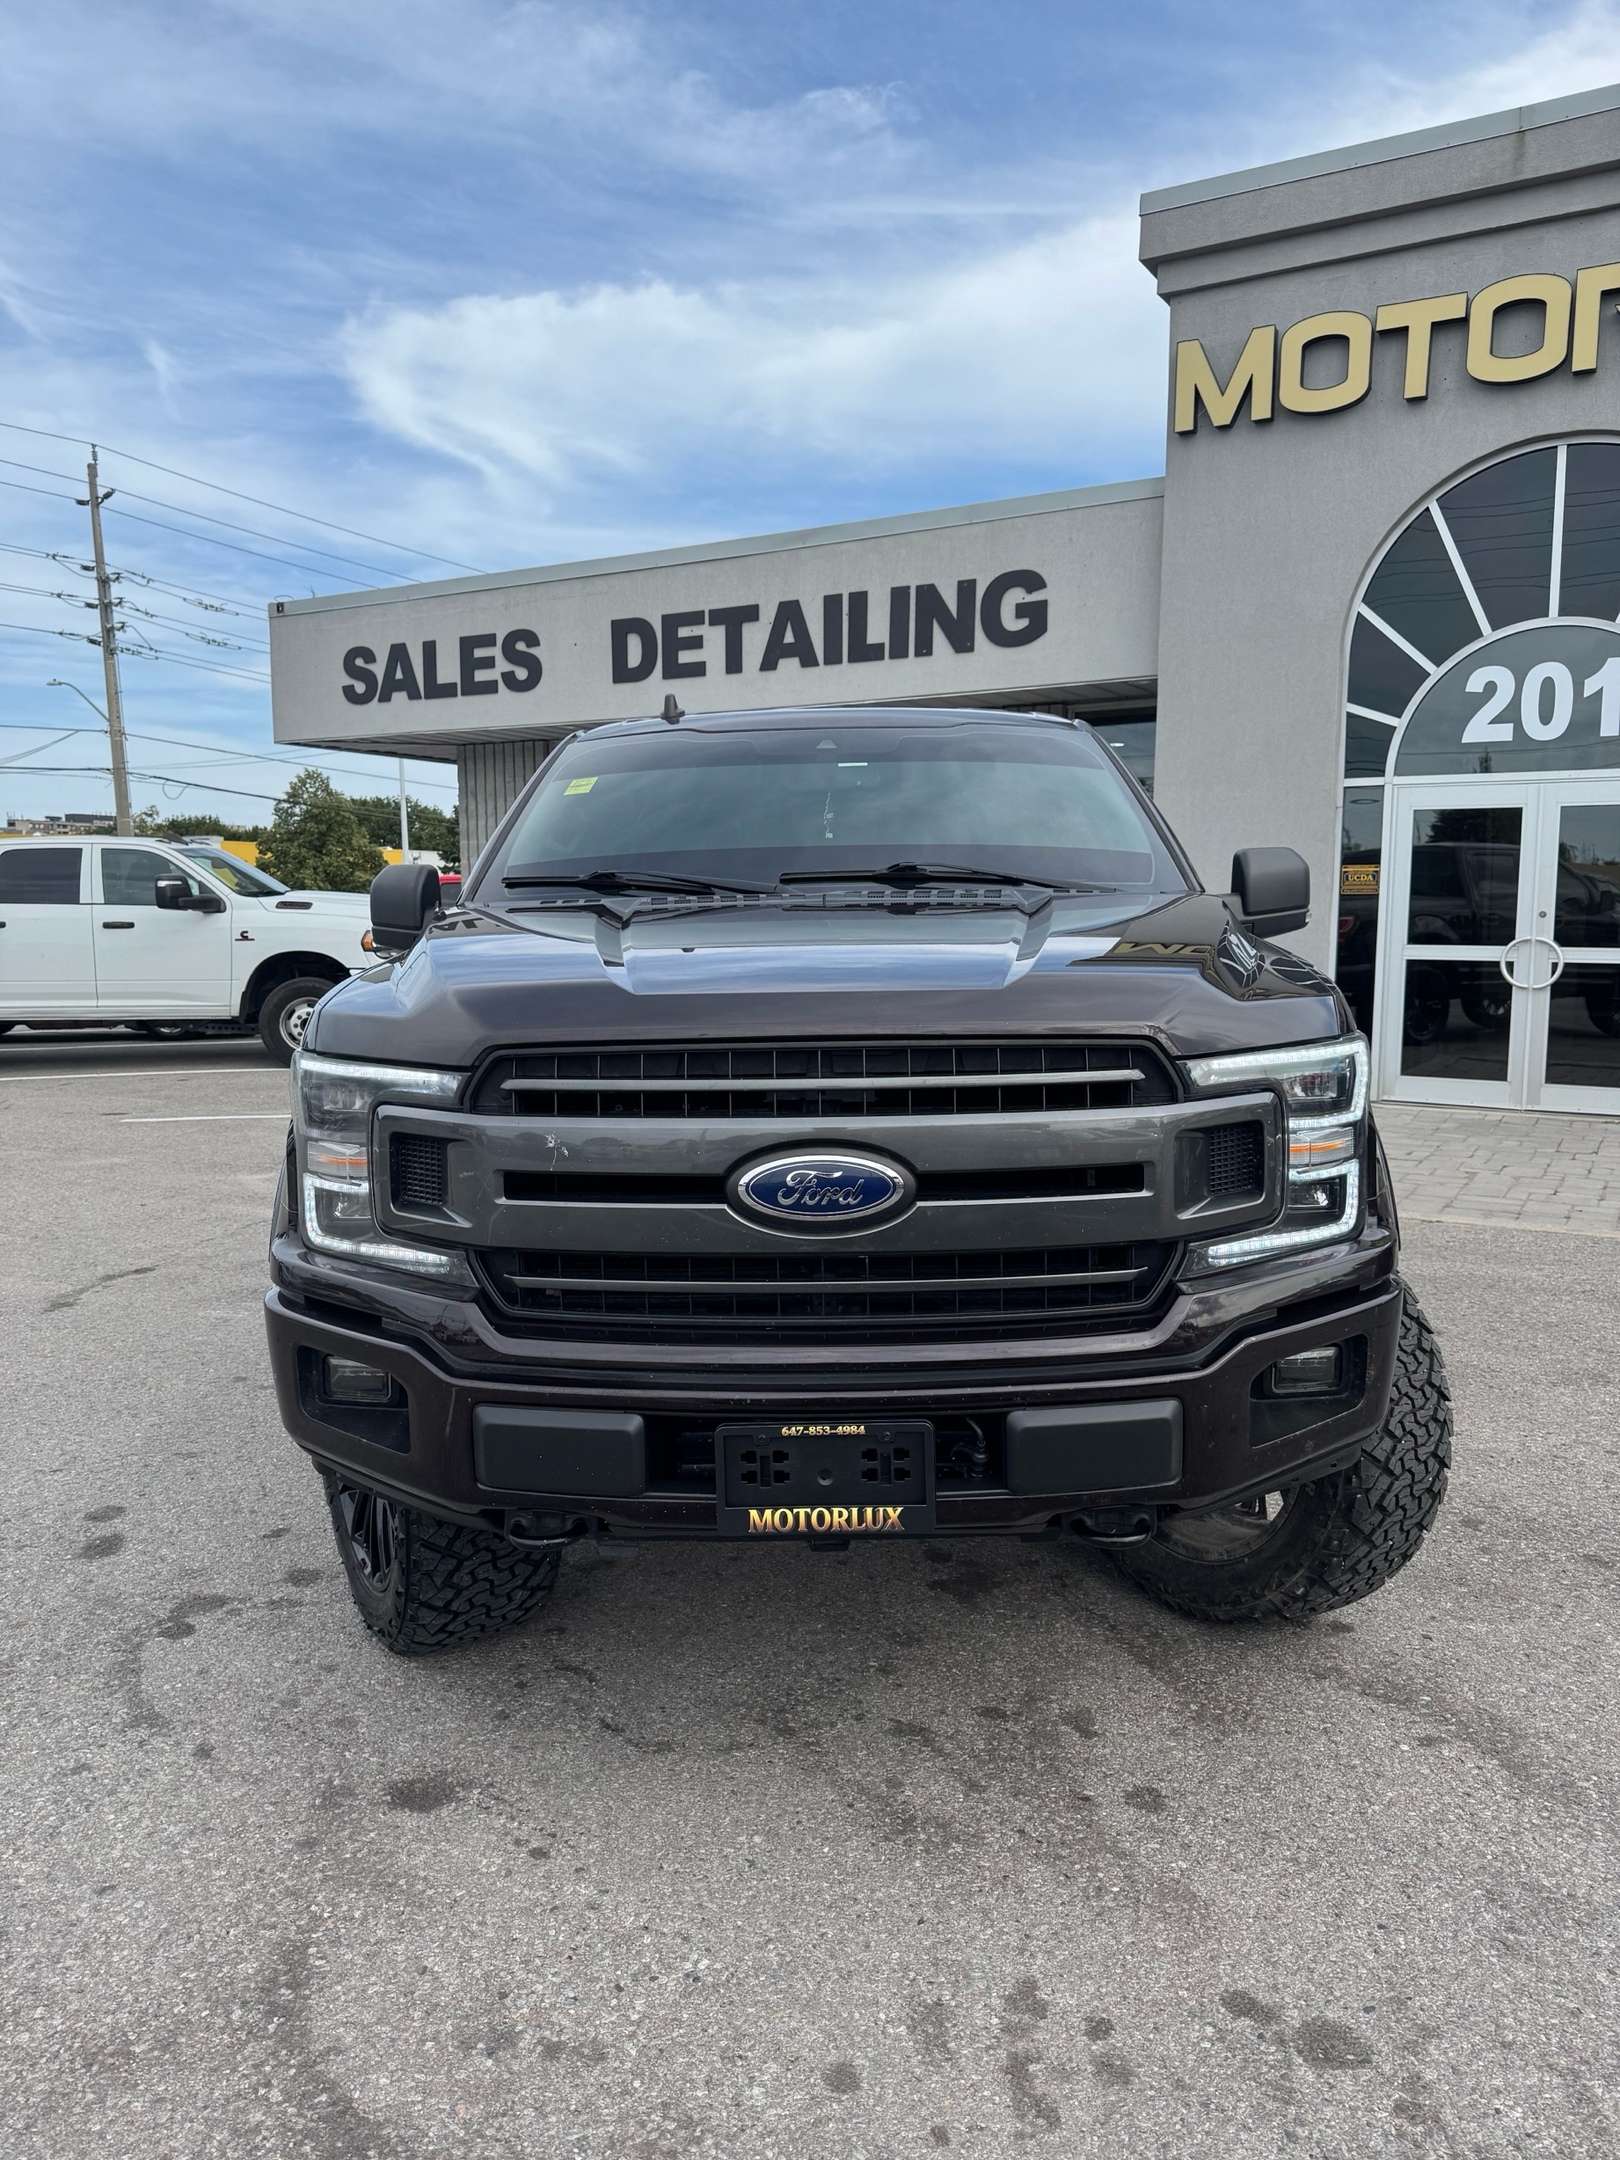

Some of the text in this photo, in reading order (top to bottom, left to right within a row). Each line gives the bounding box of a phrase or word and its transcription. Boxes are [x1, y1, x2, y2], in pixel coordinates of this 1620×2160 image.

[341, 569, 1048, 706] SALES DETAILING
[1461, 656, 1620, 743] 201
[777, 1170, 864, 1206] Ford
[781, 1425, 866, 1437] 647-853-4984
[748, 1507, 905, 1533] MOTORLUX
